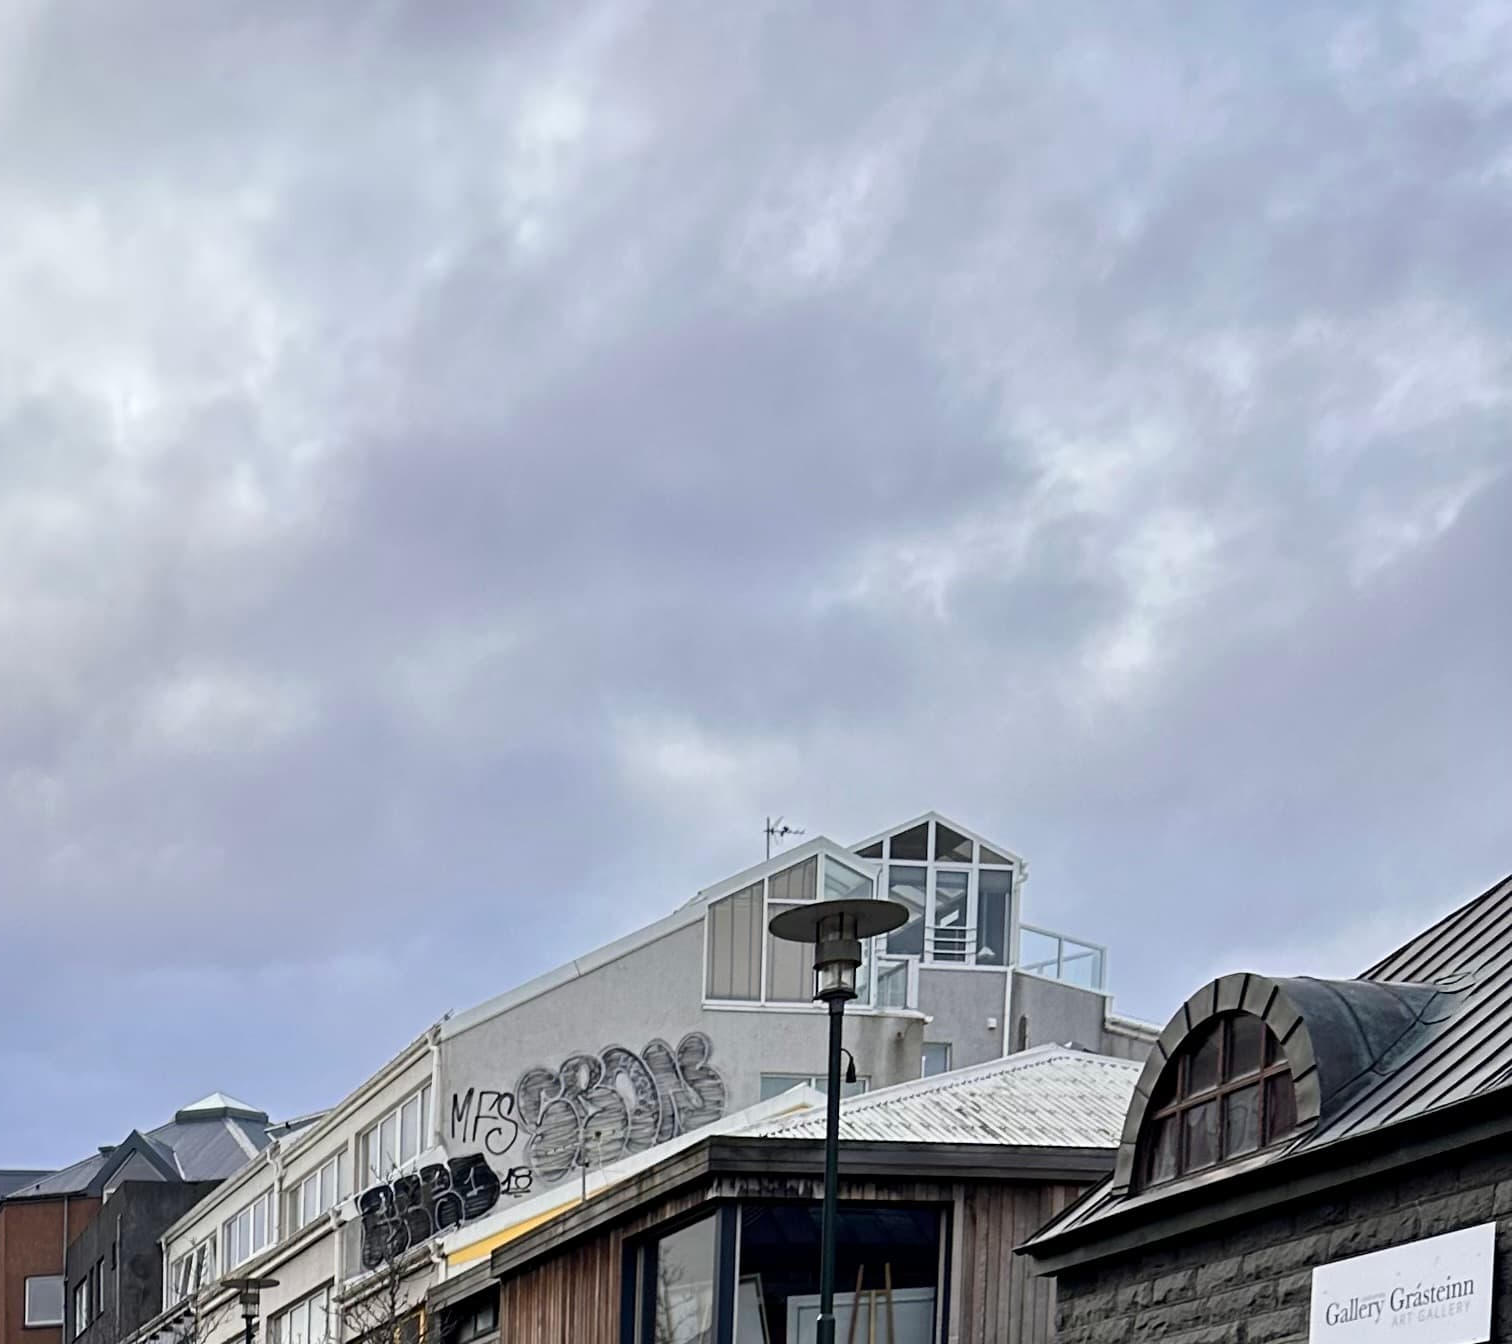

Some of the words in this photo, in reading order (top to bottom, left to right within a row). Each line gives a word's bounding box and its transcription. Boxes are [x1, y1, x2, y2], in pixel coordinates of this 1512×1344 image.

[1325, 1296, 1386, 1327] Gallery
[1390, 1276, 1475, 1312] Grásteinn
[1392, 1311, 1414, 1328] ART
[1418, 1301, 1472, 1323] GALLERY
